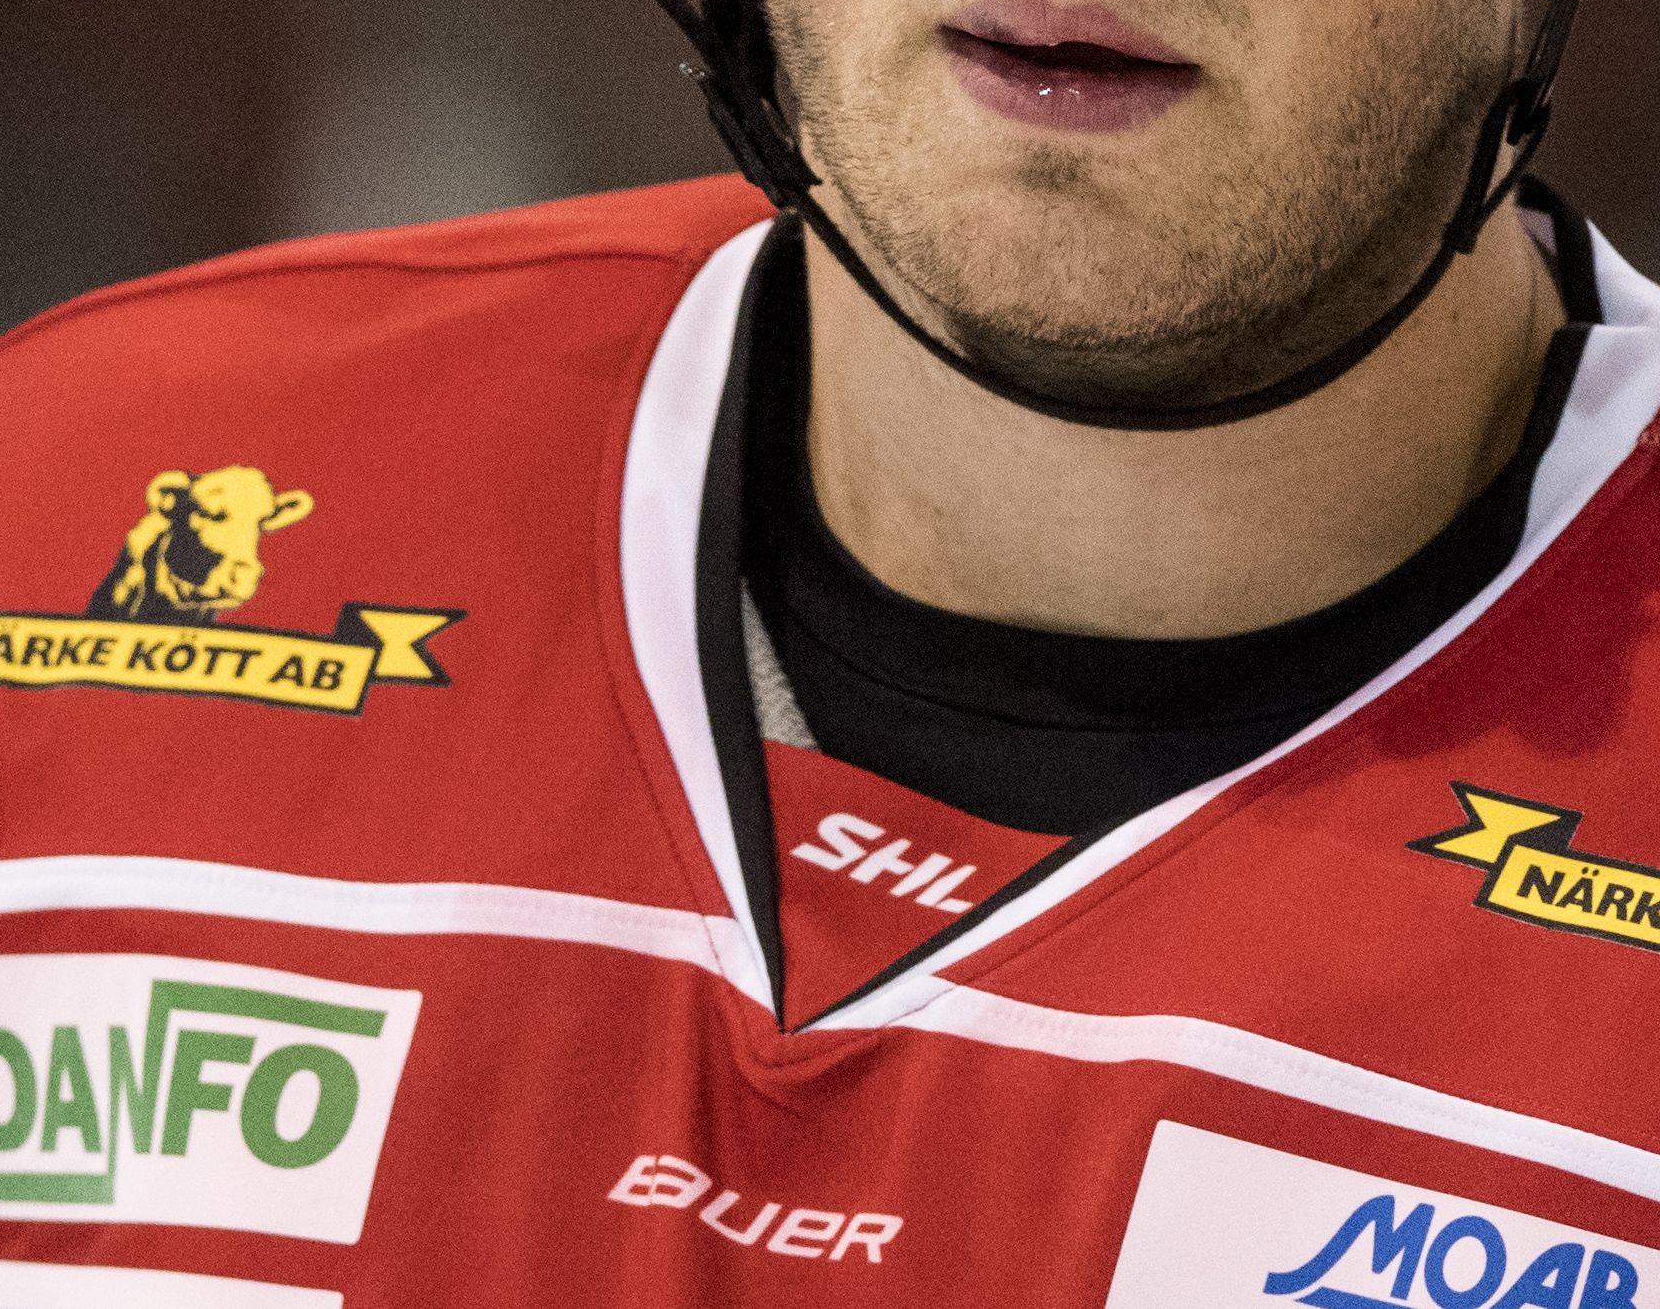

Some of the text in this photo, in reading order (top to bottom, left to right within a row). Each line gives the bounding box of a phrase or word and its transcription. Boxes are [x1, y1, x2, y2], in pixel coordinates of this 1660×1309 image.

[126, 629, 262, 679] KÖTT
[268, 654, 347, 692] AB
[790, 812, 977, 914] SHL
